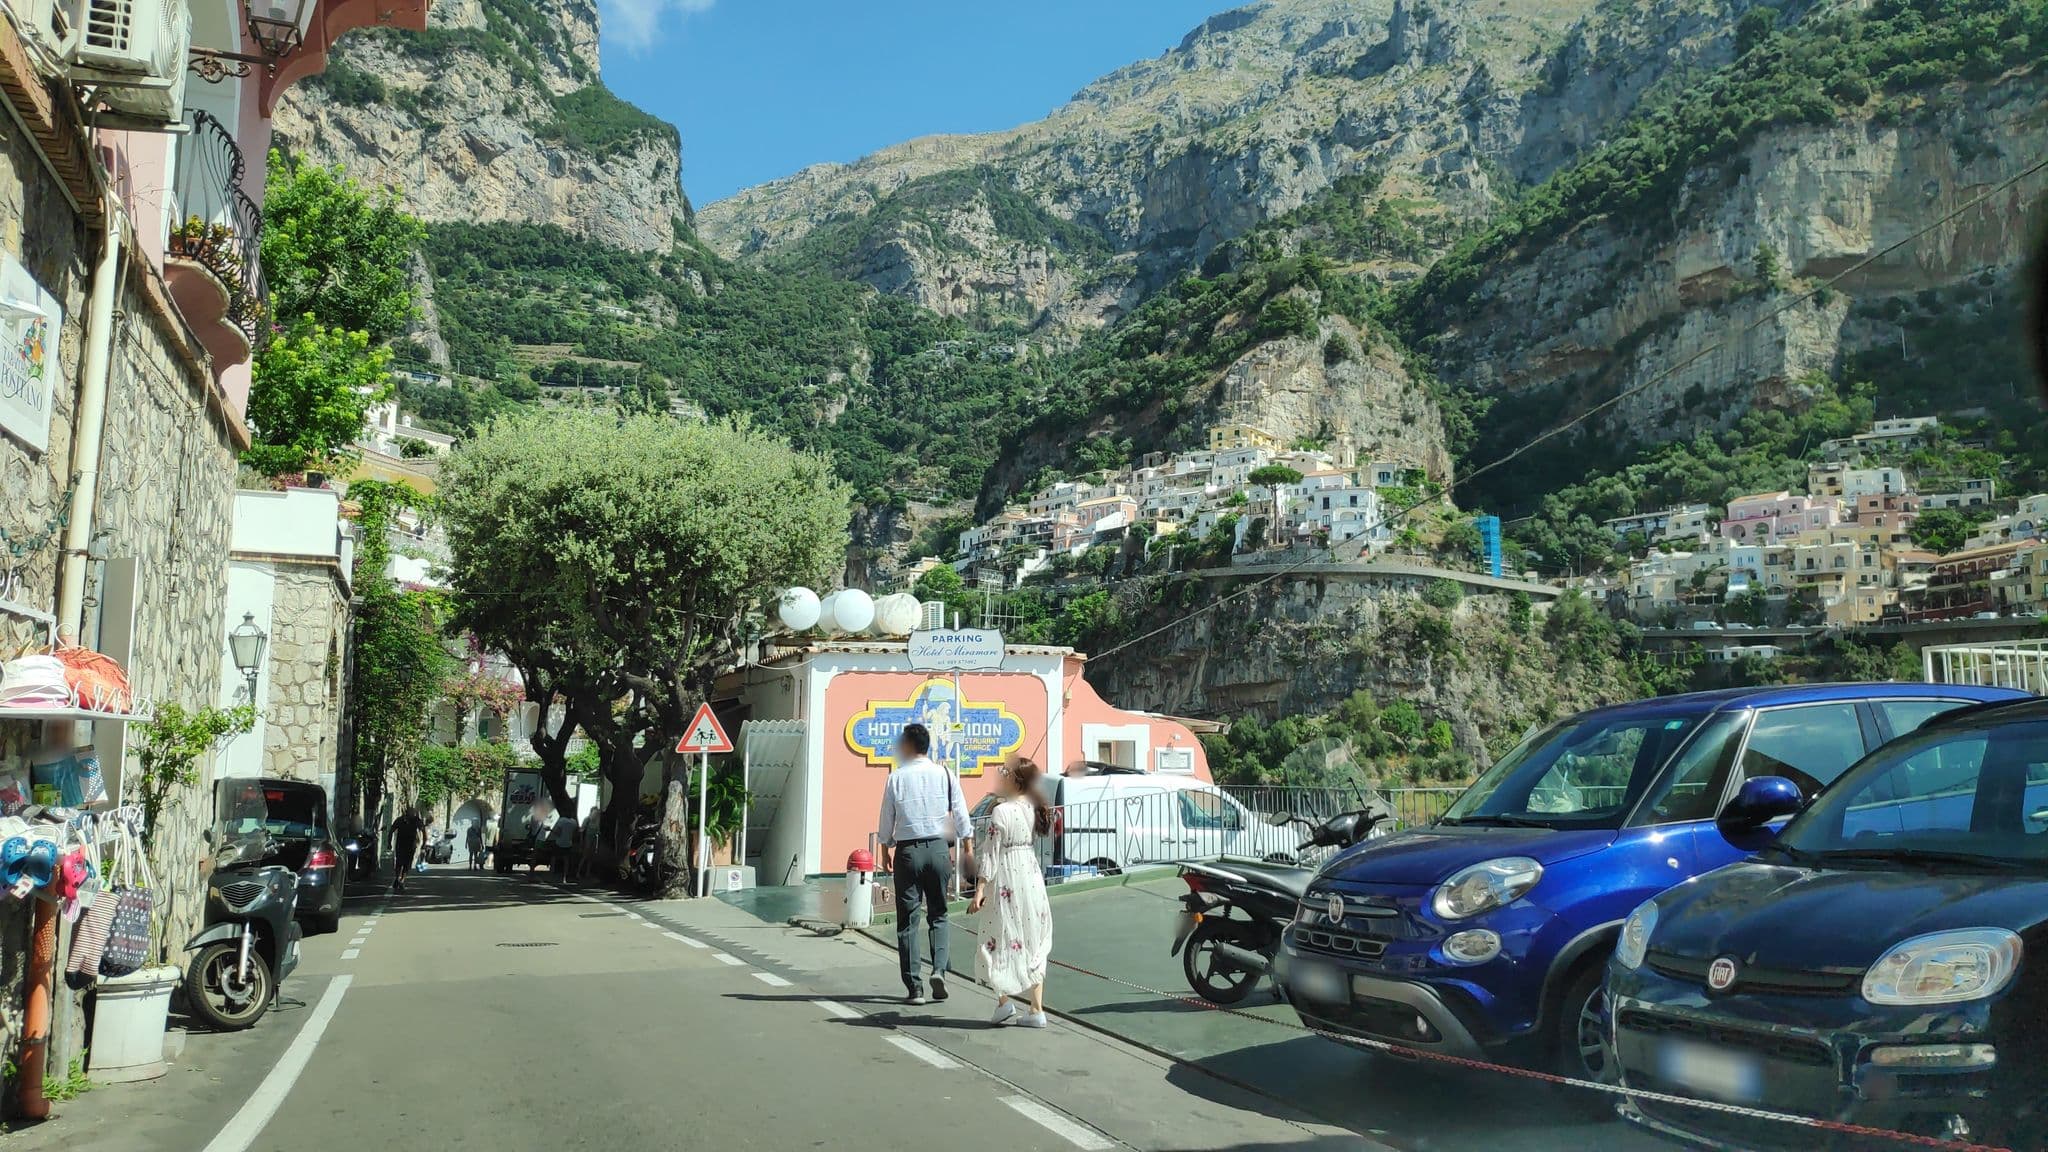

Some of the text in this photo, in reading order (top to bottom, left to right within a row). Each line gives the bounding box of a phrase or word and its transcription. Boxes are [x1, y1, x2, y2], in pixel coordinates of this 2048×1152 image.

[932, 635, 982, 643] PARKING
[912, 644, 997, 657] Hotel Miramare
[868, 723, 908, 736] HOT
[1713, 966, 1730, 982] FIAT
